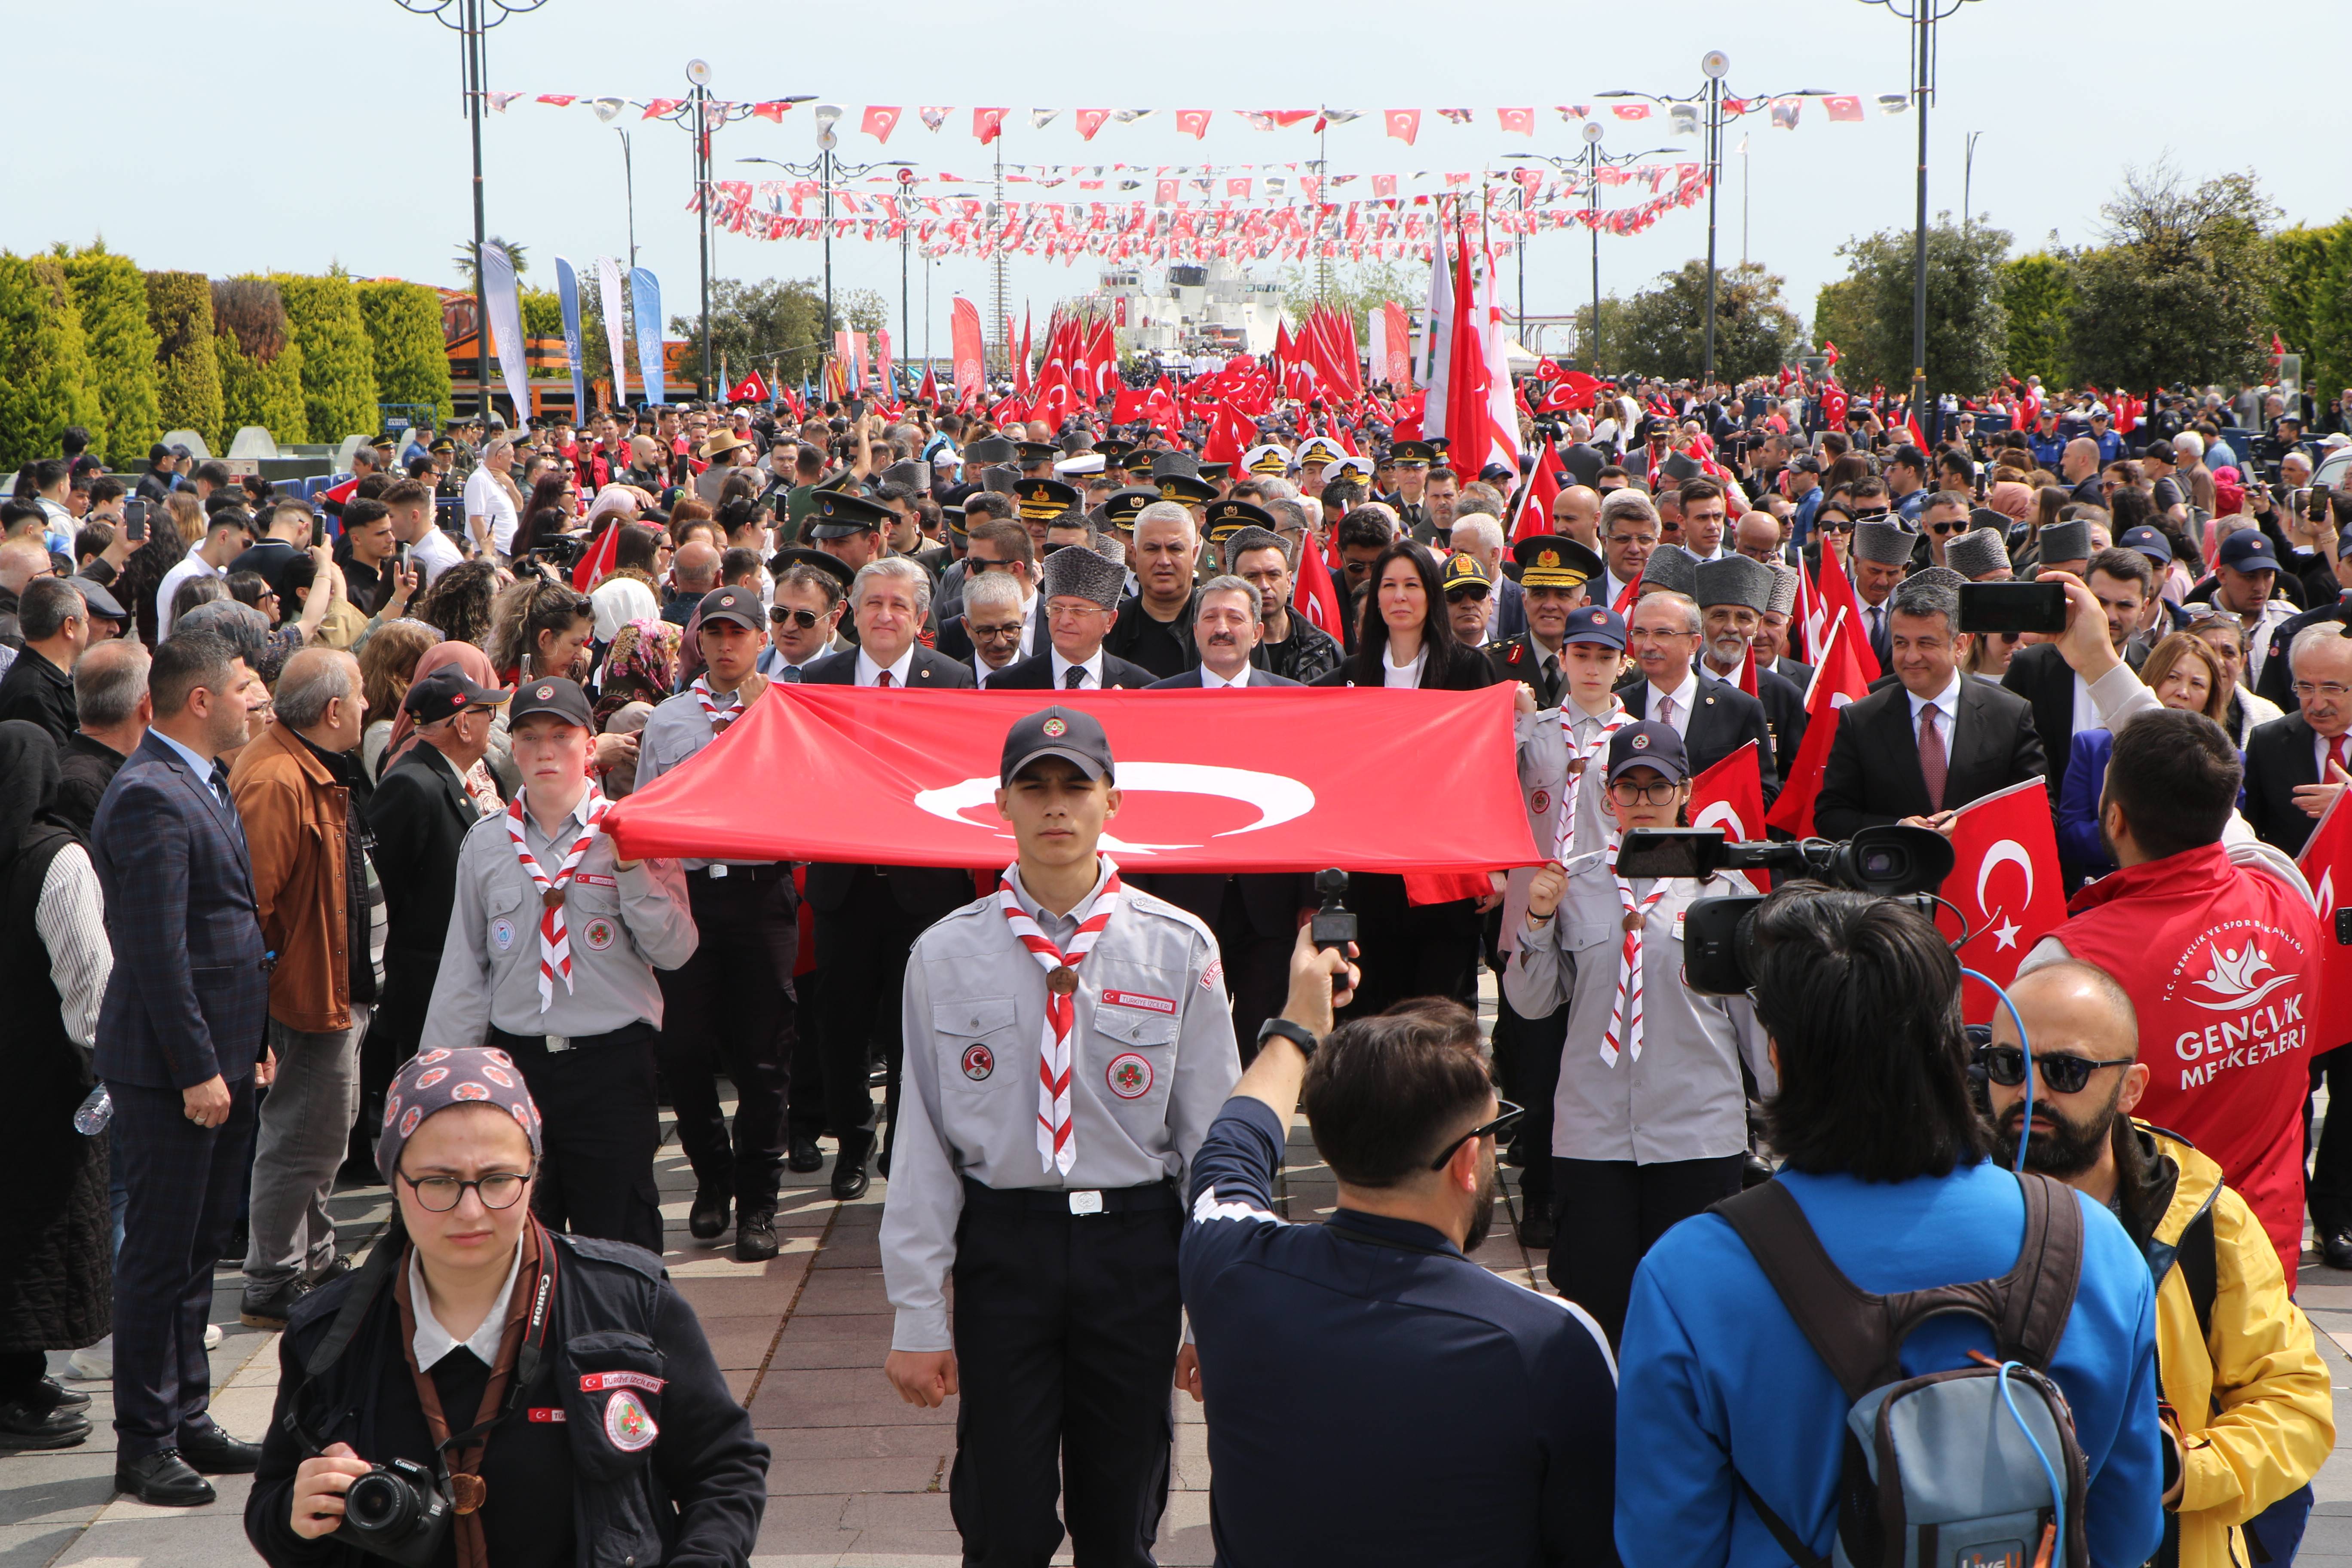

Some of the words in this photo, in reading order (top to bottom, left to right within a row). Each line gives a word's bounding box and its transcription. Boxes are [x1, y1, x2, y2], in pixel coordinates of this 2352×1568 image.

[2163, 980, 2176, 1001] T.C.
[2174, 935, 2206, 976] GENÇLİK
[2207, 925, 2221, 936] VE
[2223, 919, 2251, 930] SPOR
[1123, 996, 1146, 1006] TÜRKİYE
[1148, 999, 1170, 1010] İZCİLERİ
[2176, 993, 2303, 1061] GENÇLİK
[533, 1274, 550, 1326] Canon
[603, 1375, 628, 1385] TÜRKİYE
[630, 1375, 659, 1390] İZCİLERİ
[395, 1459, 417, 1472] Canon
